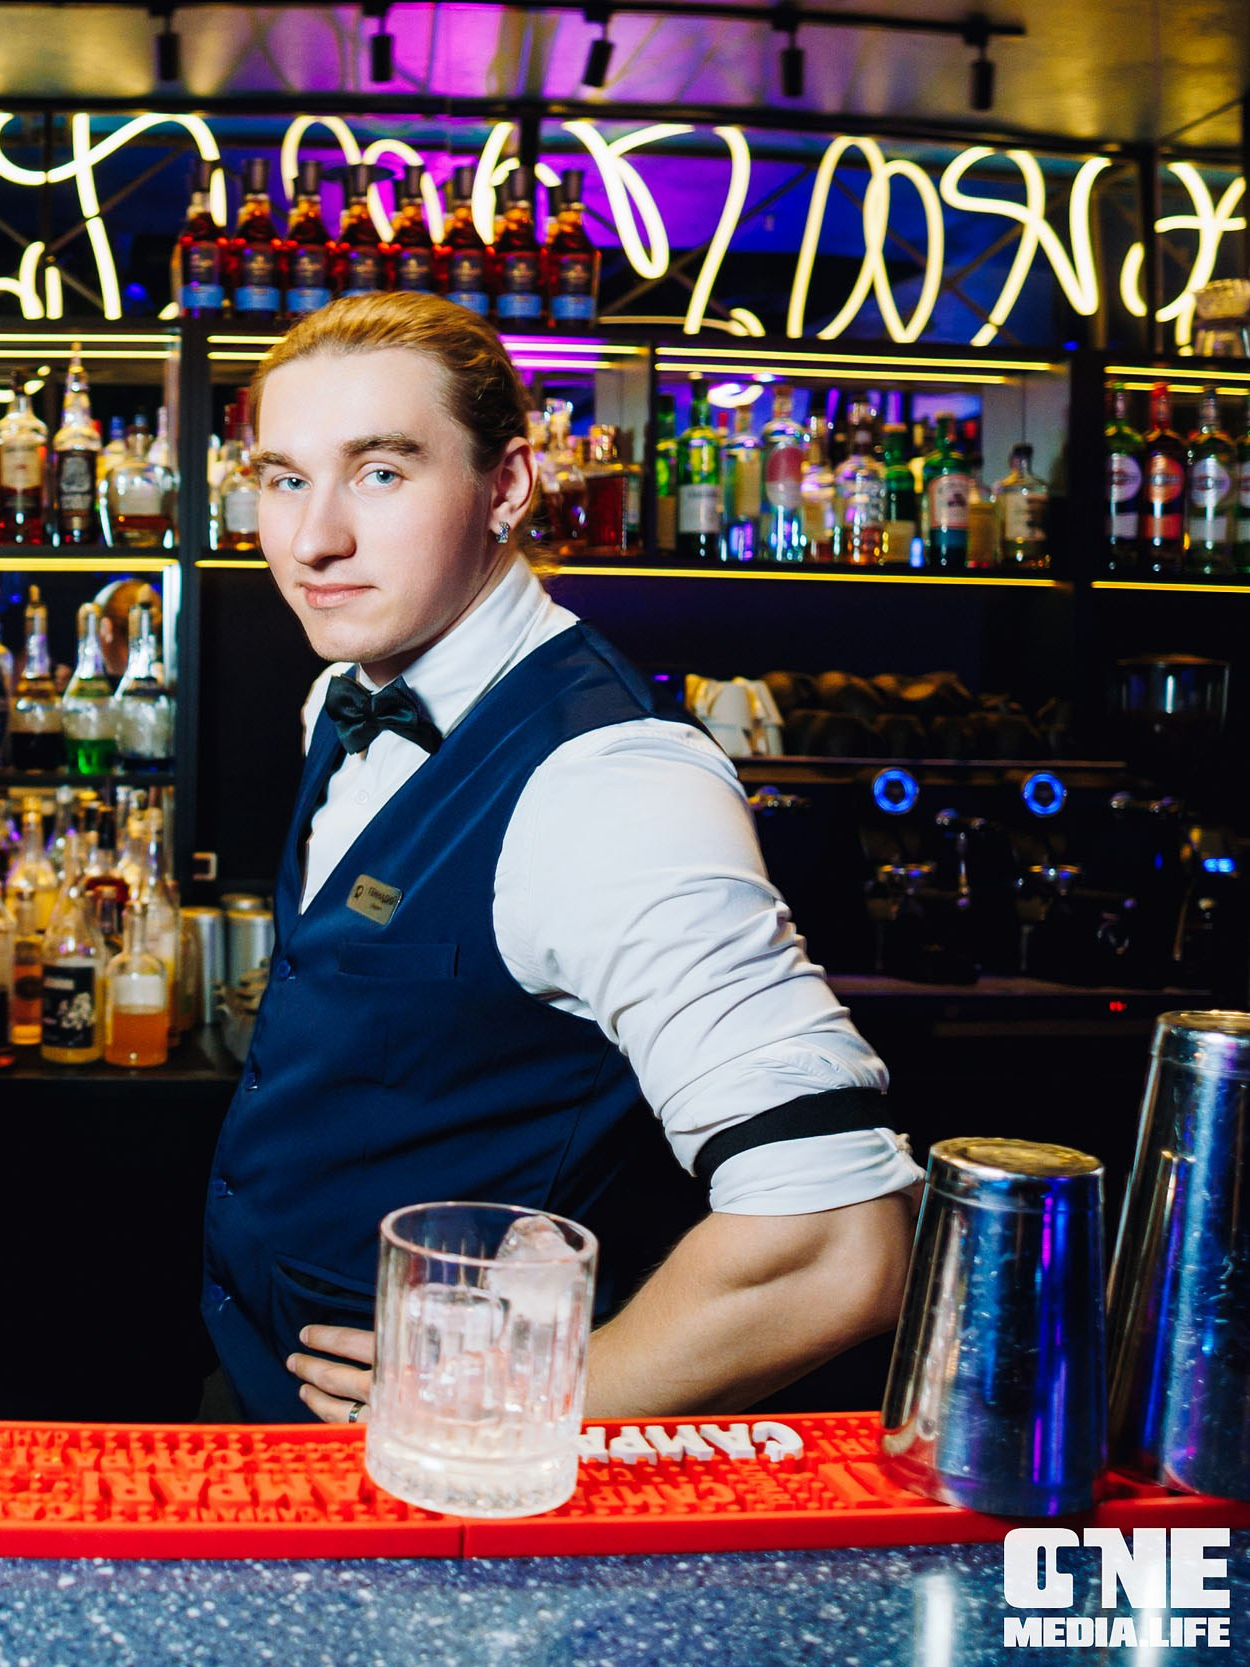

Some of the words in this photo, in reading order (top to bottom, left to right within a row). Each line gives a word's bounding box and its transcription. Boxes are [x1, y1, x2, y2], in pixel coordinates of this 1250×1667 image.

[14, 1446, 244, 1471] CAMPARI
[576, 1421, 804, 1465] CAMPA
[82, 1472, 365, 1505] AMPARI
